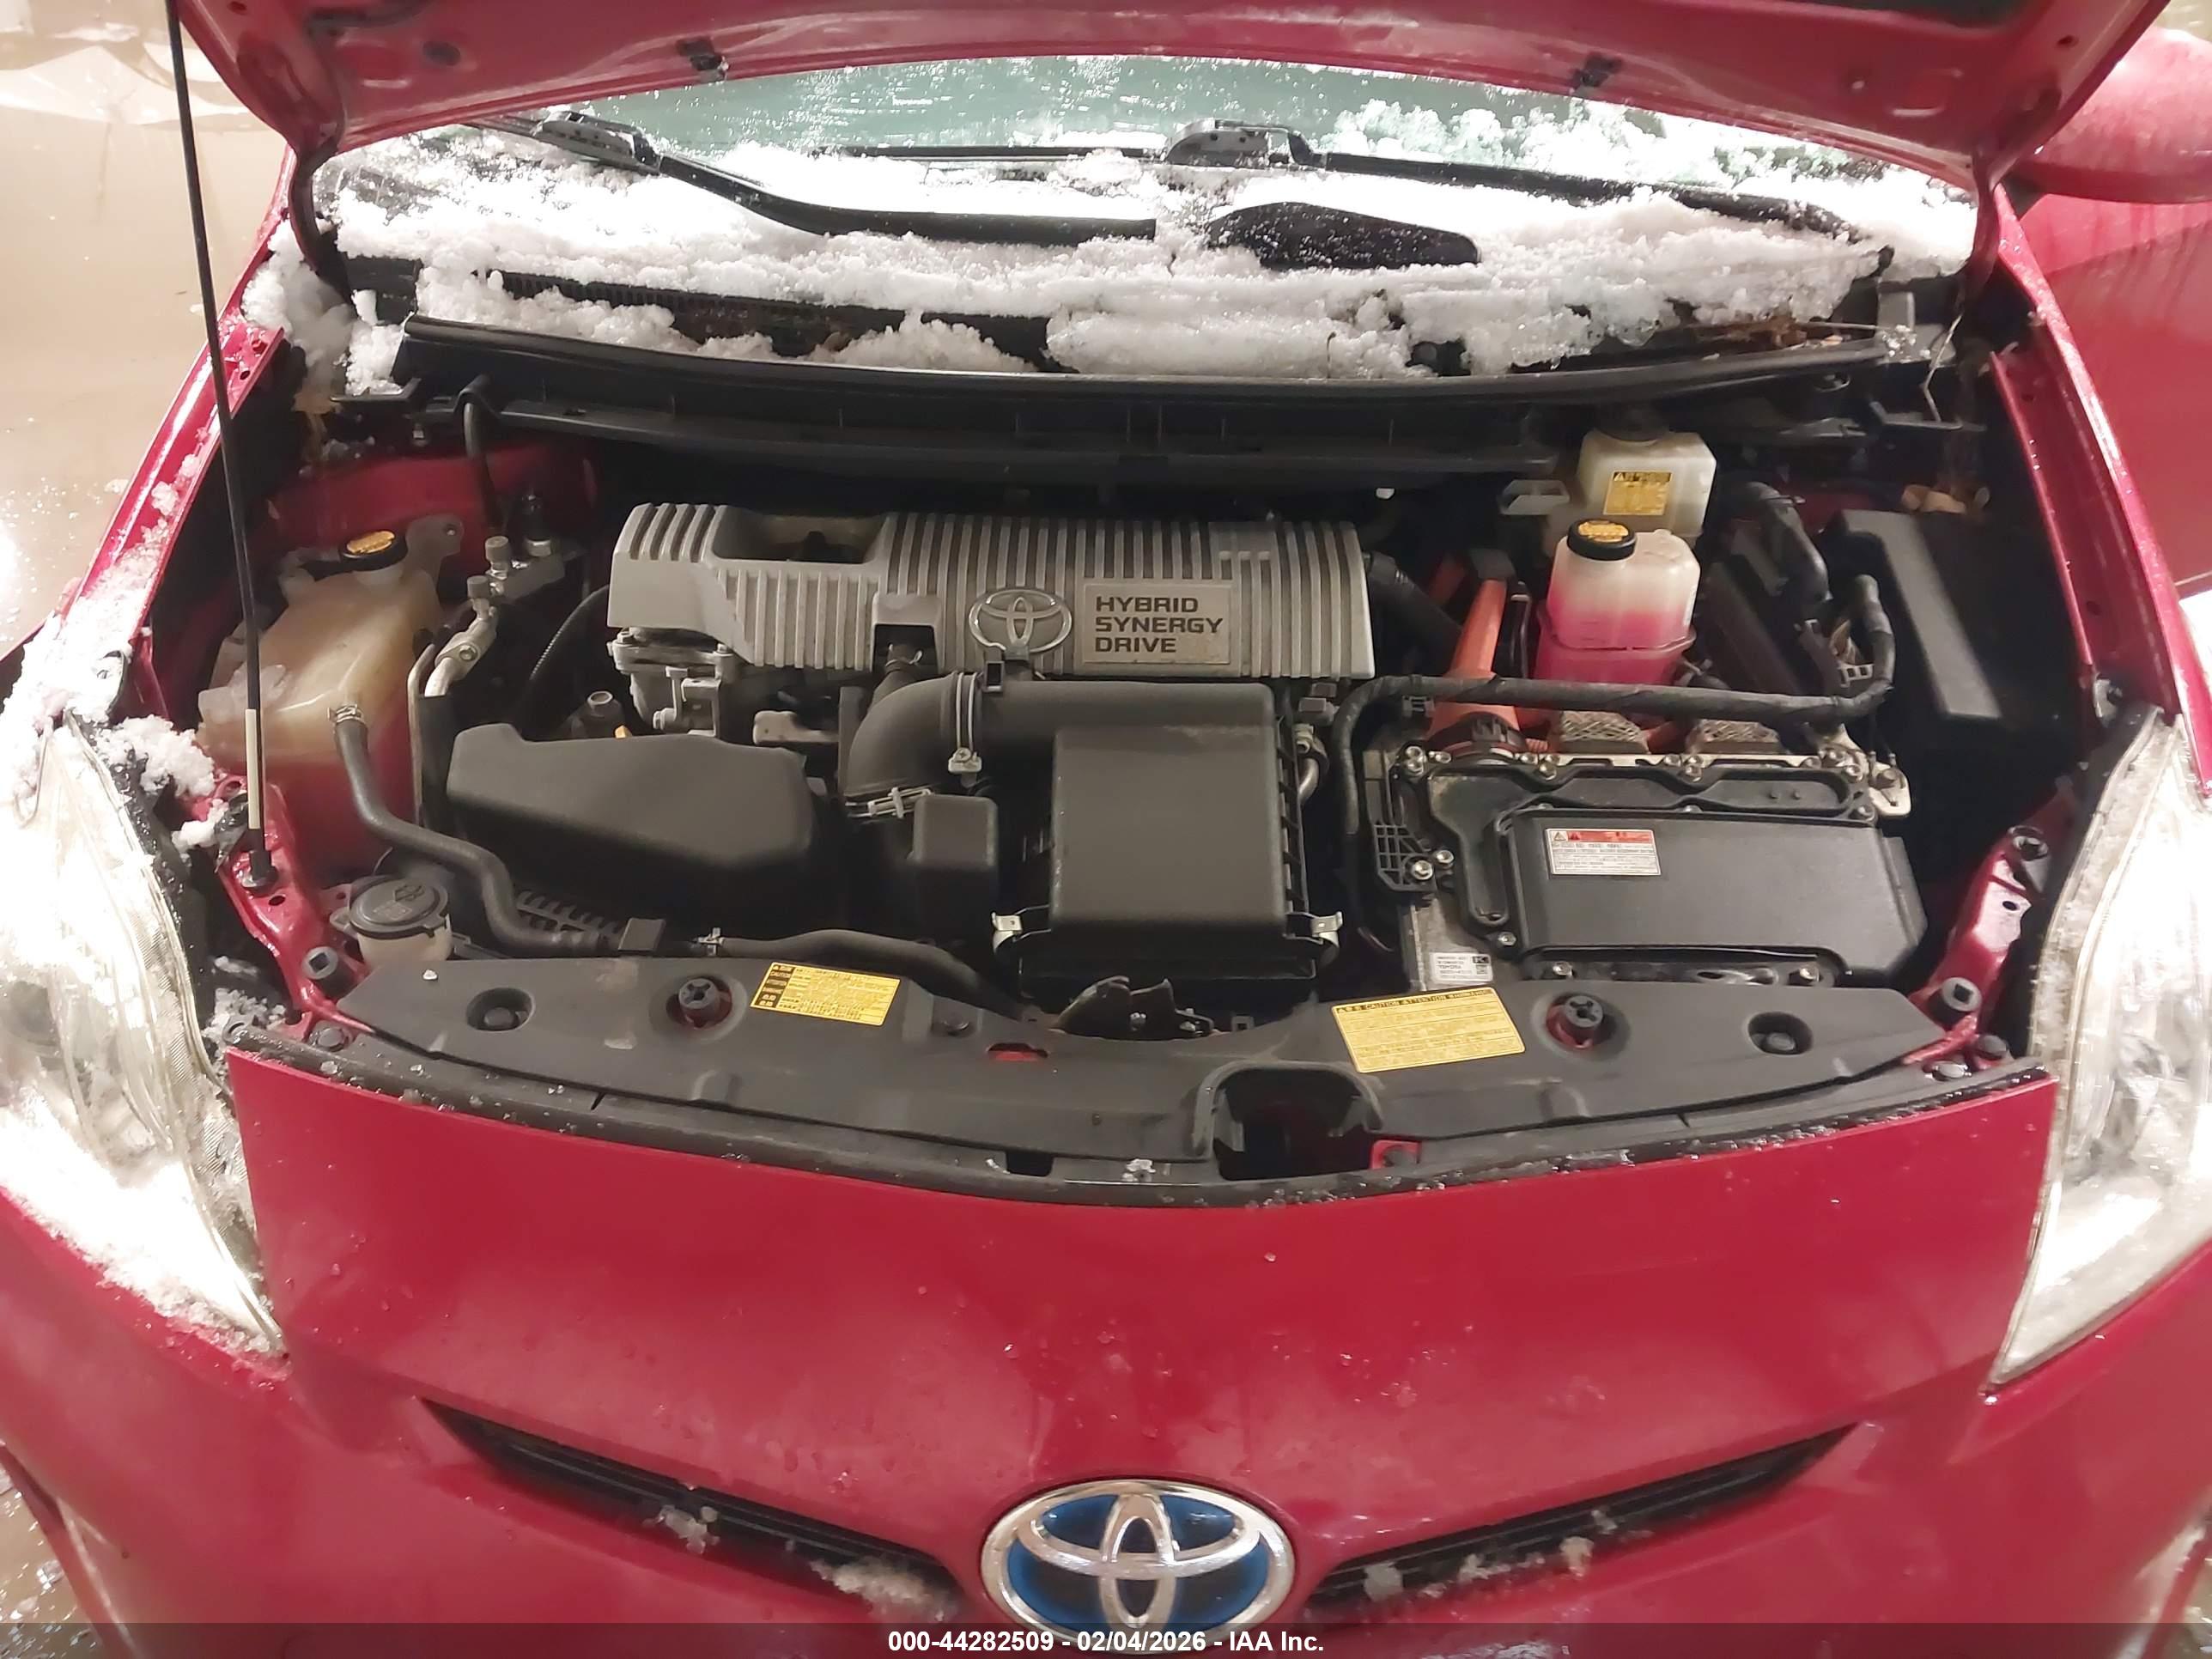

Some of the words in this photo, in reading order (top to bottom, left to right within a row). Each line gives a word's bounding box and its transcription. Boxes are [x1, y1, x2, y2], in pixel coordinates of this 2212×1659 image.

[1096, 596, 1199, 613] HYBRID
[1095, 617, 1224, 634] SYNERGY
[1095, 637, 1176, 653] DRIVE
[1365, 1000, 1401, 1010] CAUTION
